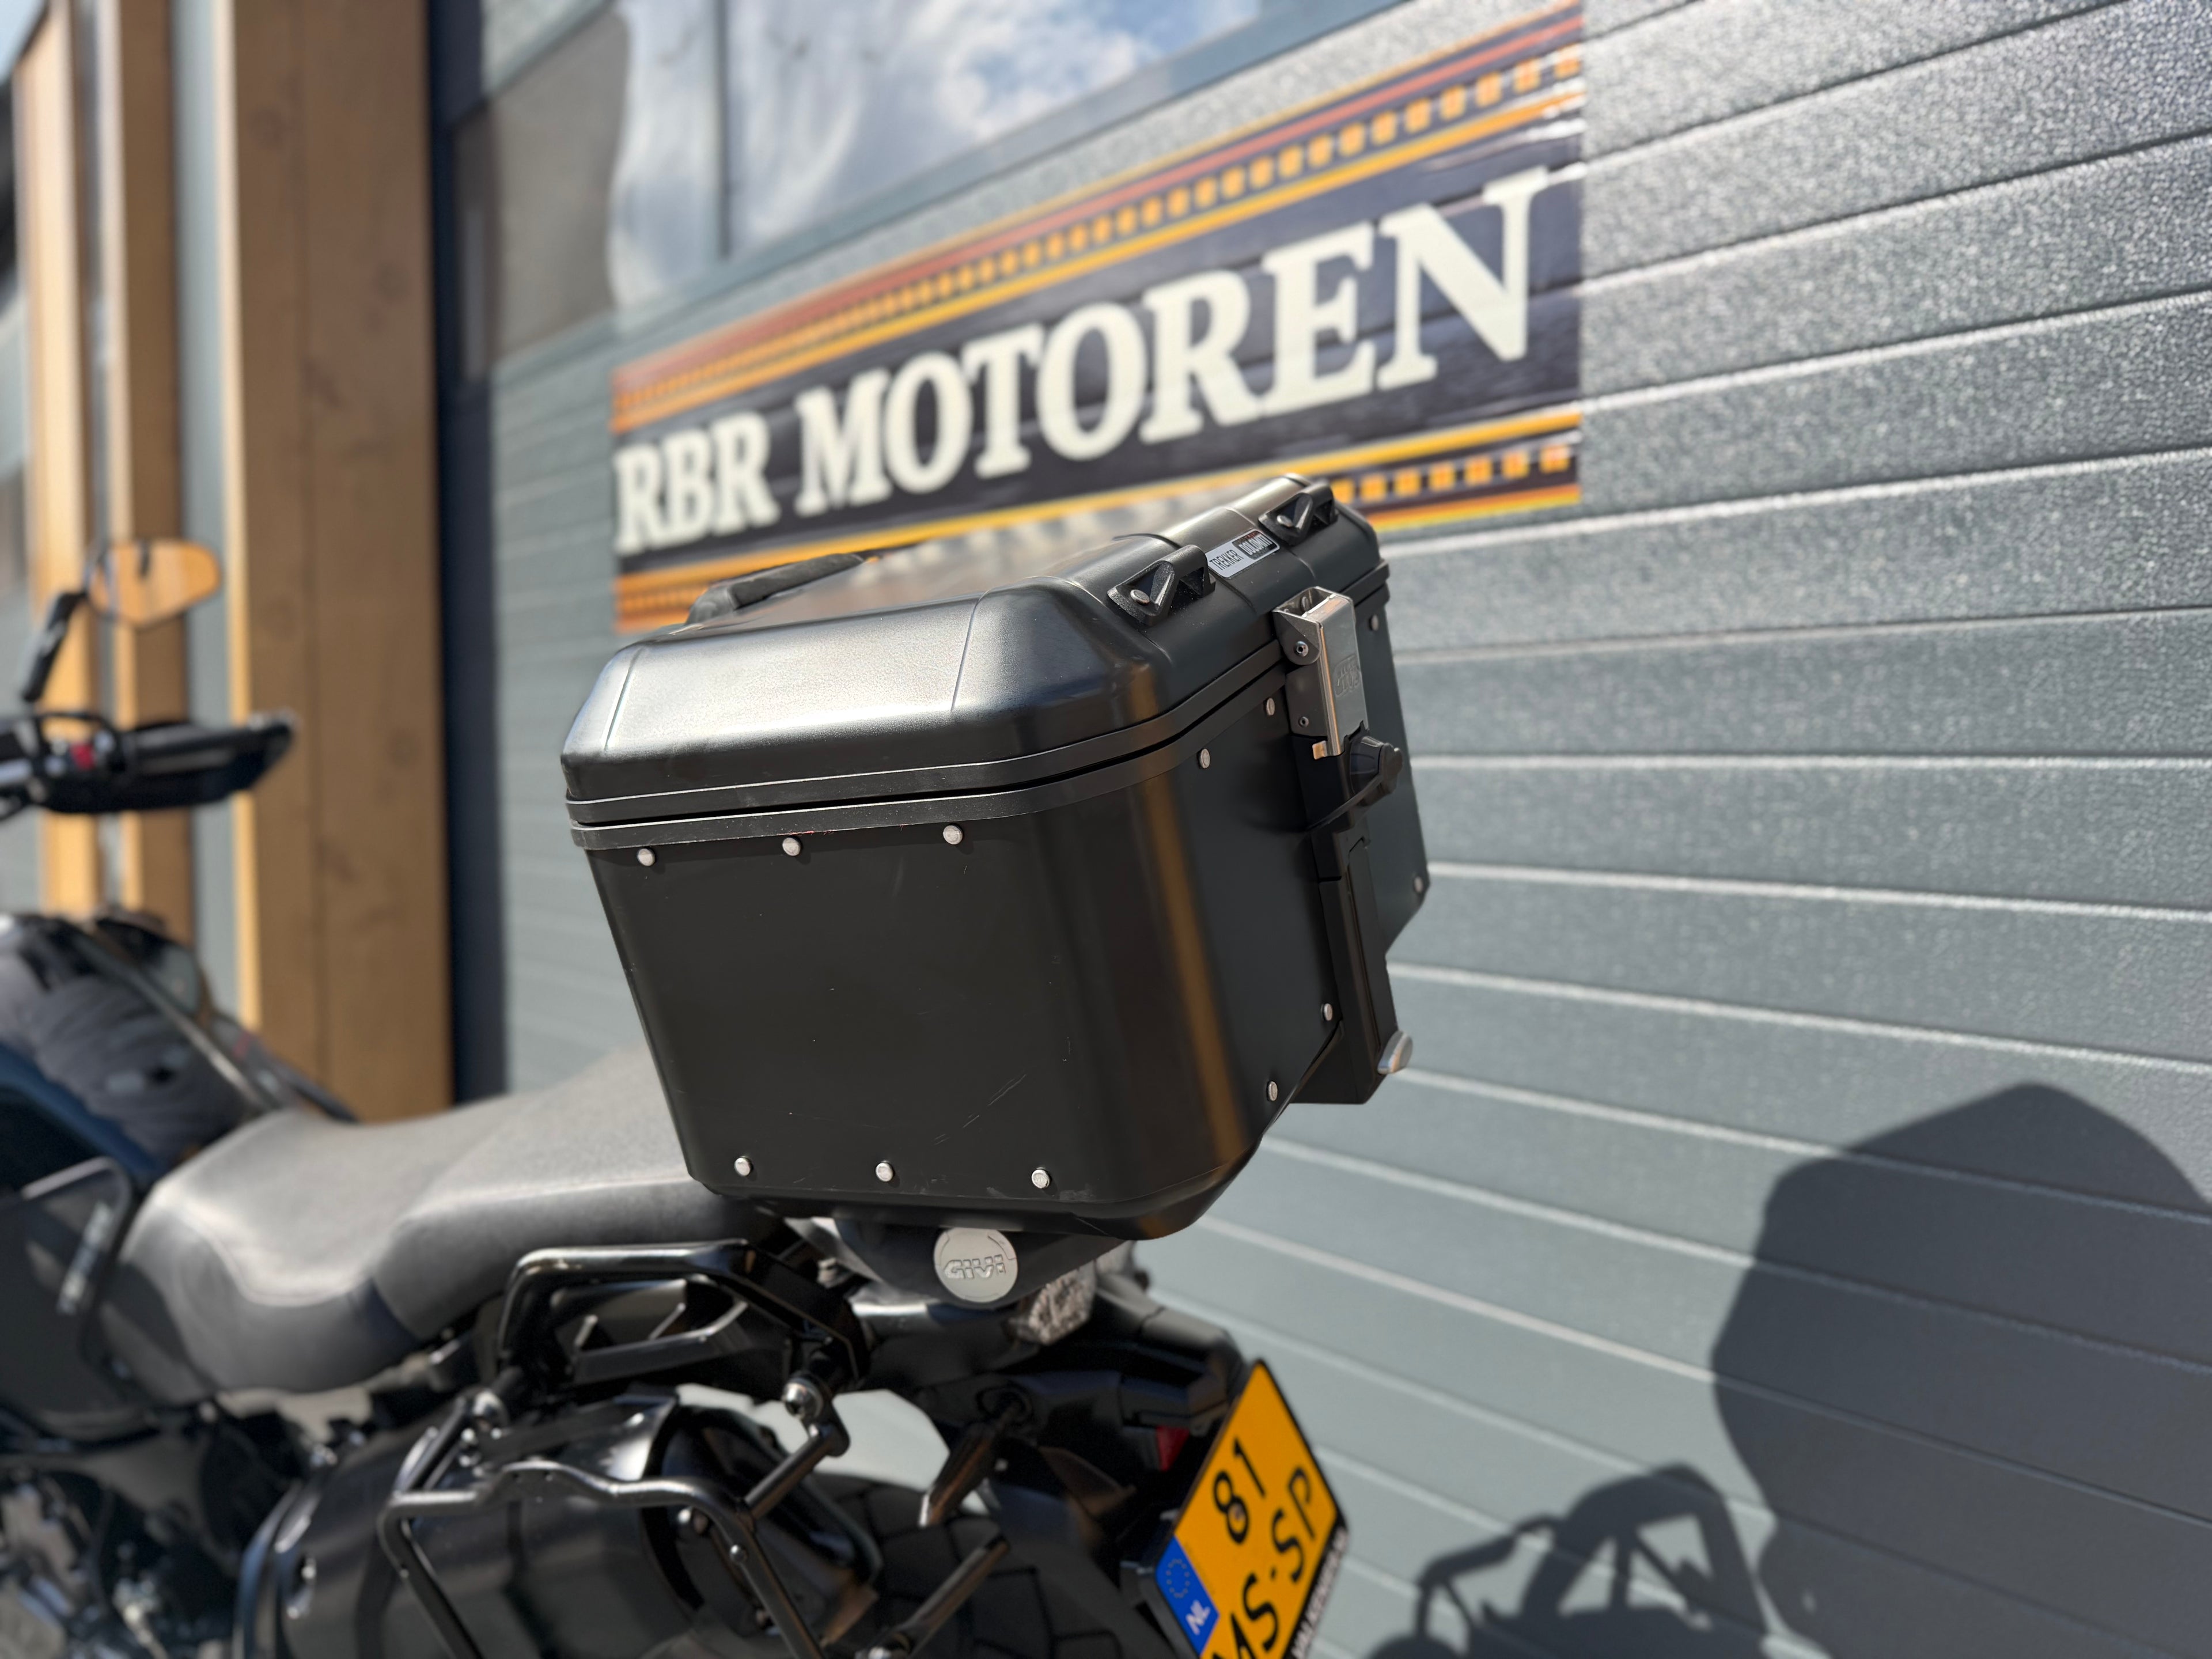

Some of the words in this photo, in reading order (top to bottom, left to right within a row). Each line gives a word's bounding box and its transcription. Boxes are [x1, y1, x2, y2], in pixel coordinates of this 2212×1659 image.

[613, 412, 781, 555] RBR
[794, 166, 1551, 517] MOTOREN
[1210, 550, 1244, 571] TREKKER
[1238, 535, 1273, 555] DOLOMITI
[944, 1254, 1005, 1279] GIVI
[1213, 1436, 1267, 1545] 81
[1186, 1600, 1210, 1635] NL
